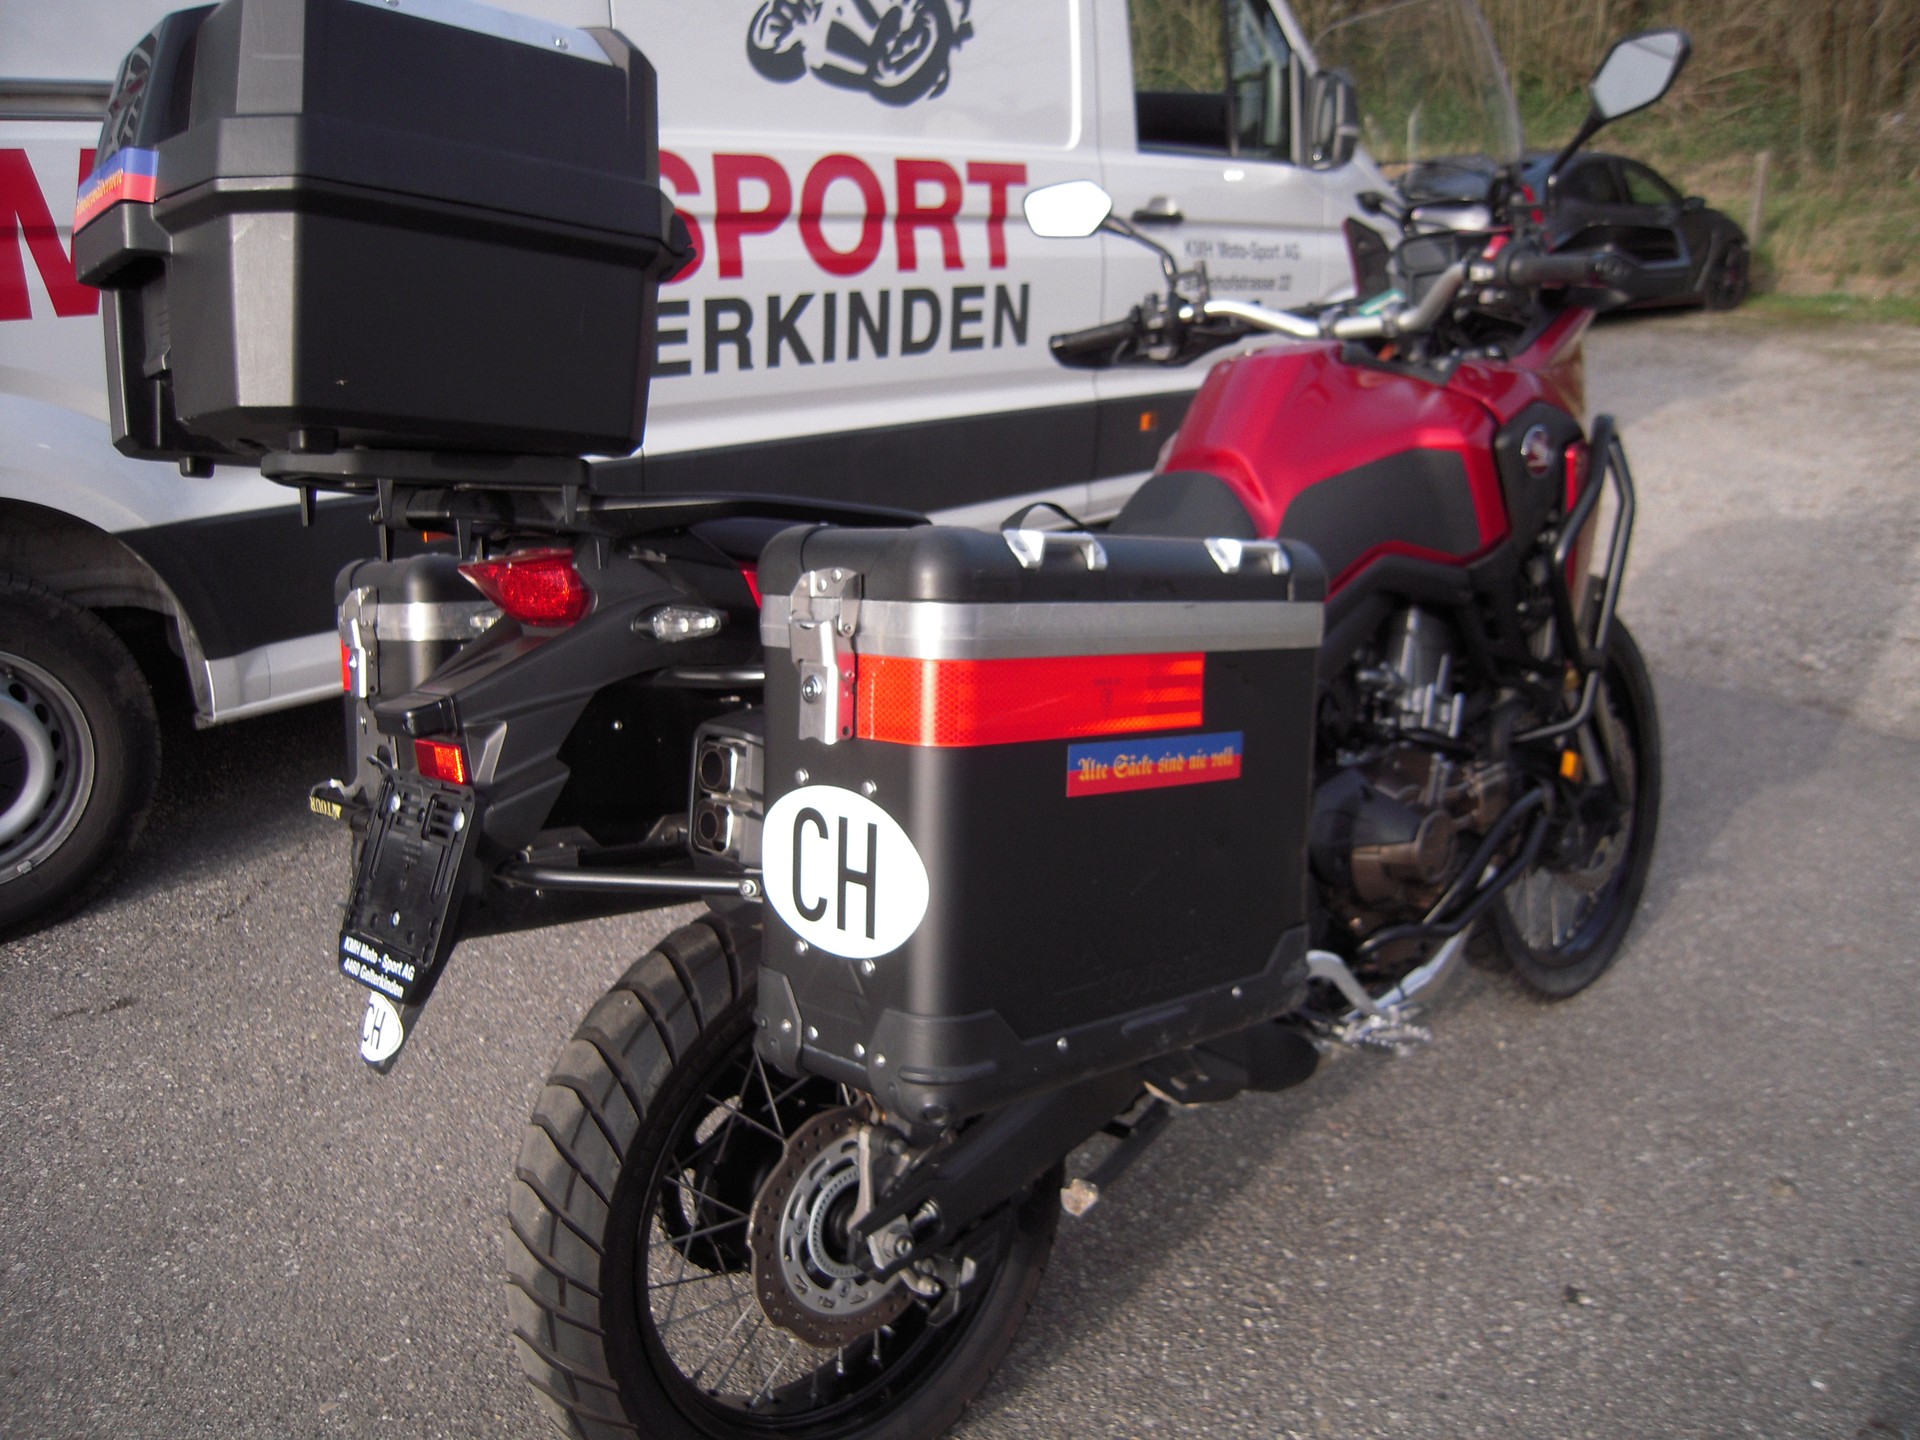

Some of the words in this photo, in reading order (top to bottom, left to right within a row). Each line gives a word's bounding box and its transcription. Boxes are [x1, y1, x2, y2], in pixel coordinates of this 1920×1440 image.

[651, 283, 1030, 377] ERKINDEN
[1157, 751, 1184, 773] sind
[792, 806, 877, 940] CH
[401, 963, 416, 982] AG
